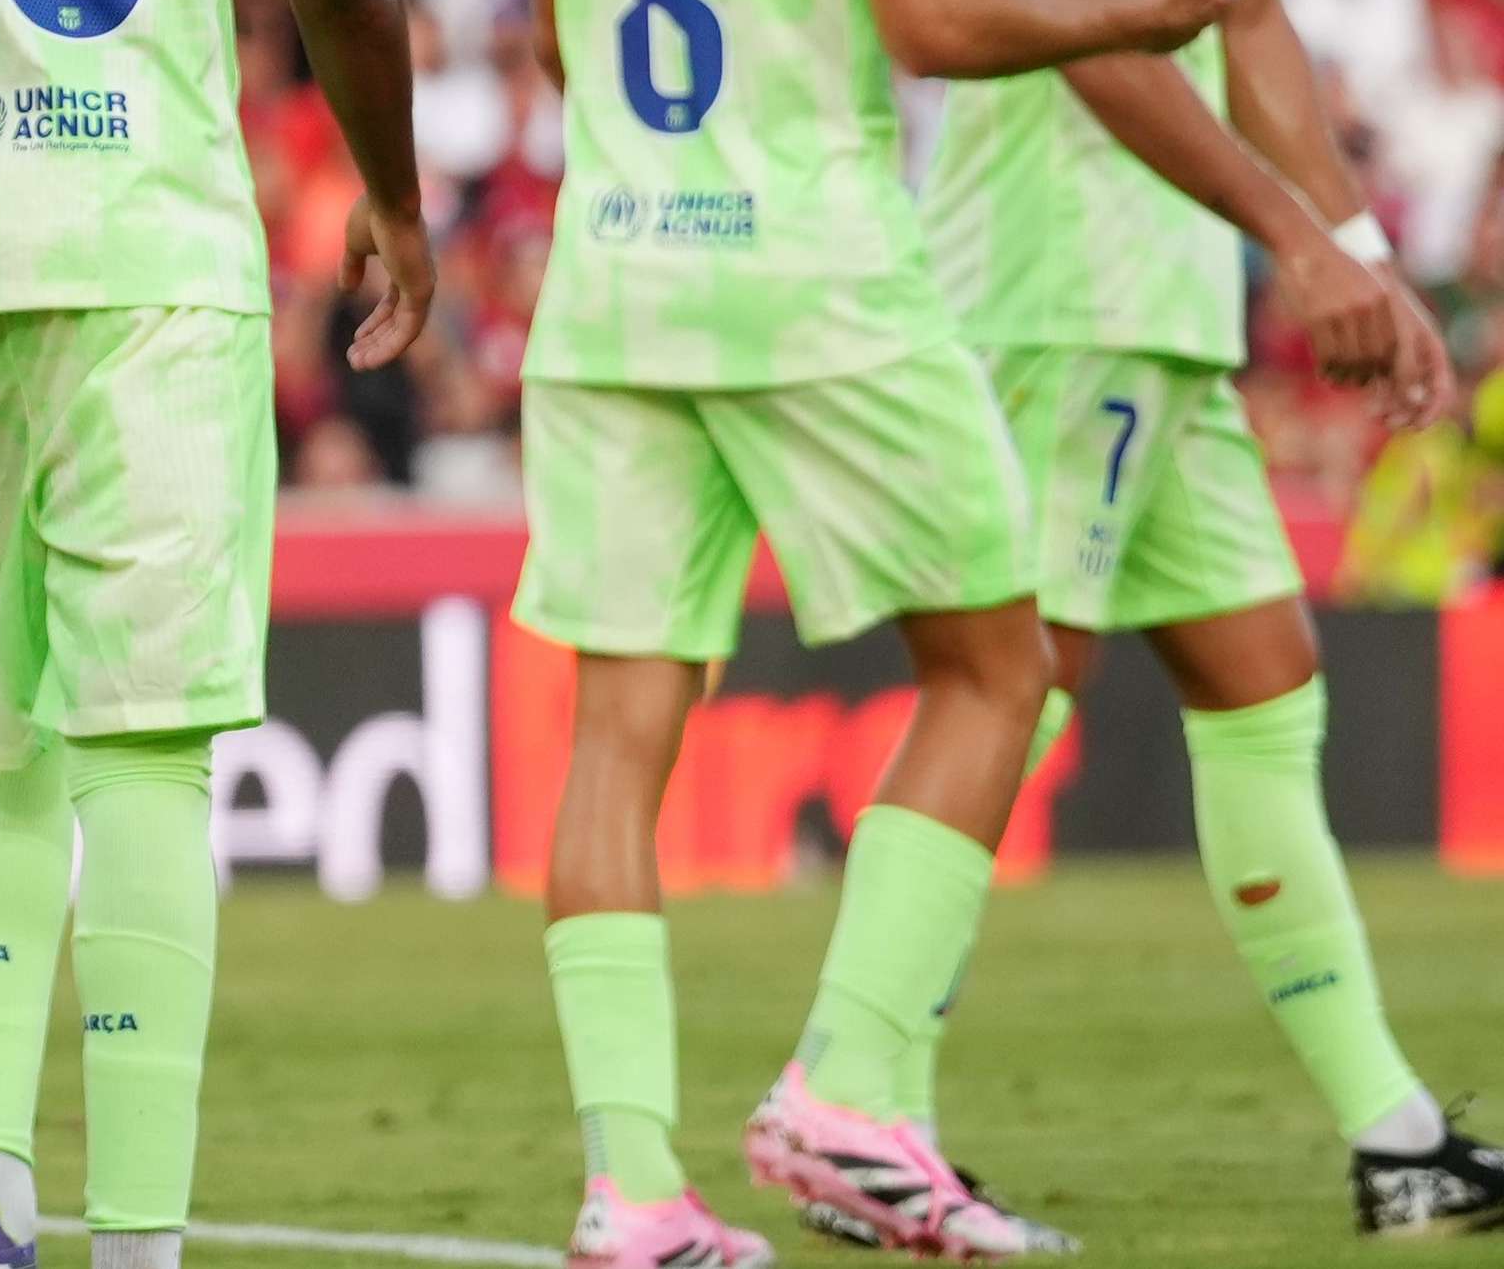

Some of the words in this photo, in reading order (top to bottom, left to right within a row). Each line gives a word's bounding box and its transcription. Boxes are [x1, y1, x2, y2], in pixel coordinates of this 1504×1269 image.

[14, 85, 128, 113] UNHCR
[12, 113, 130, 140] ACNUR
[1099, 397, 1138, 506] 7
